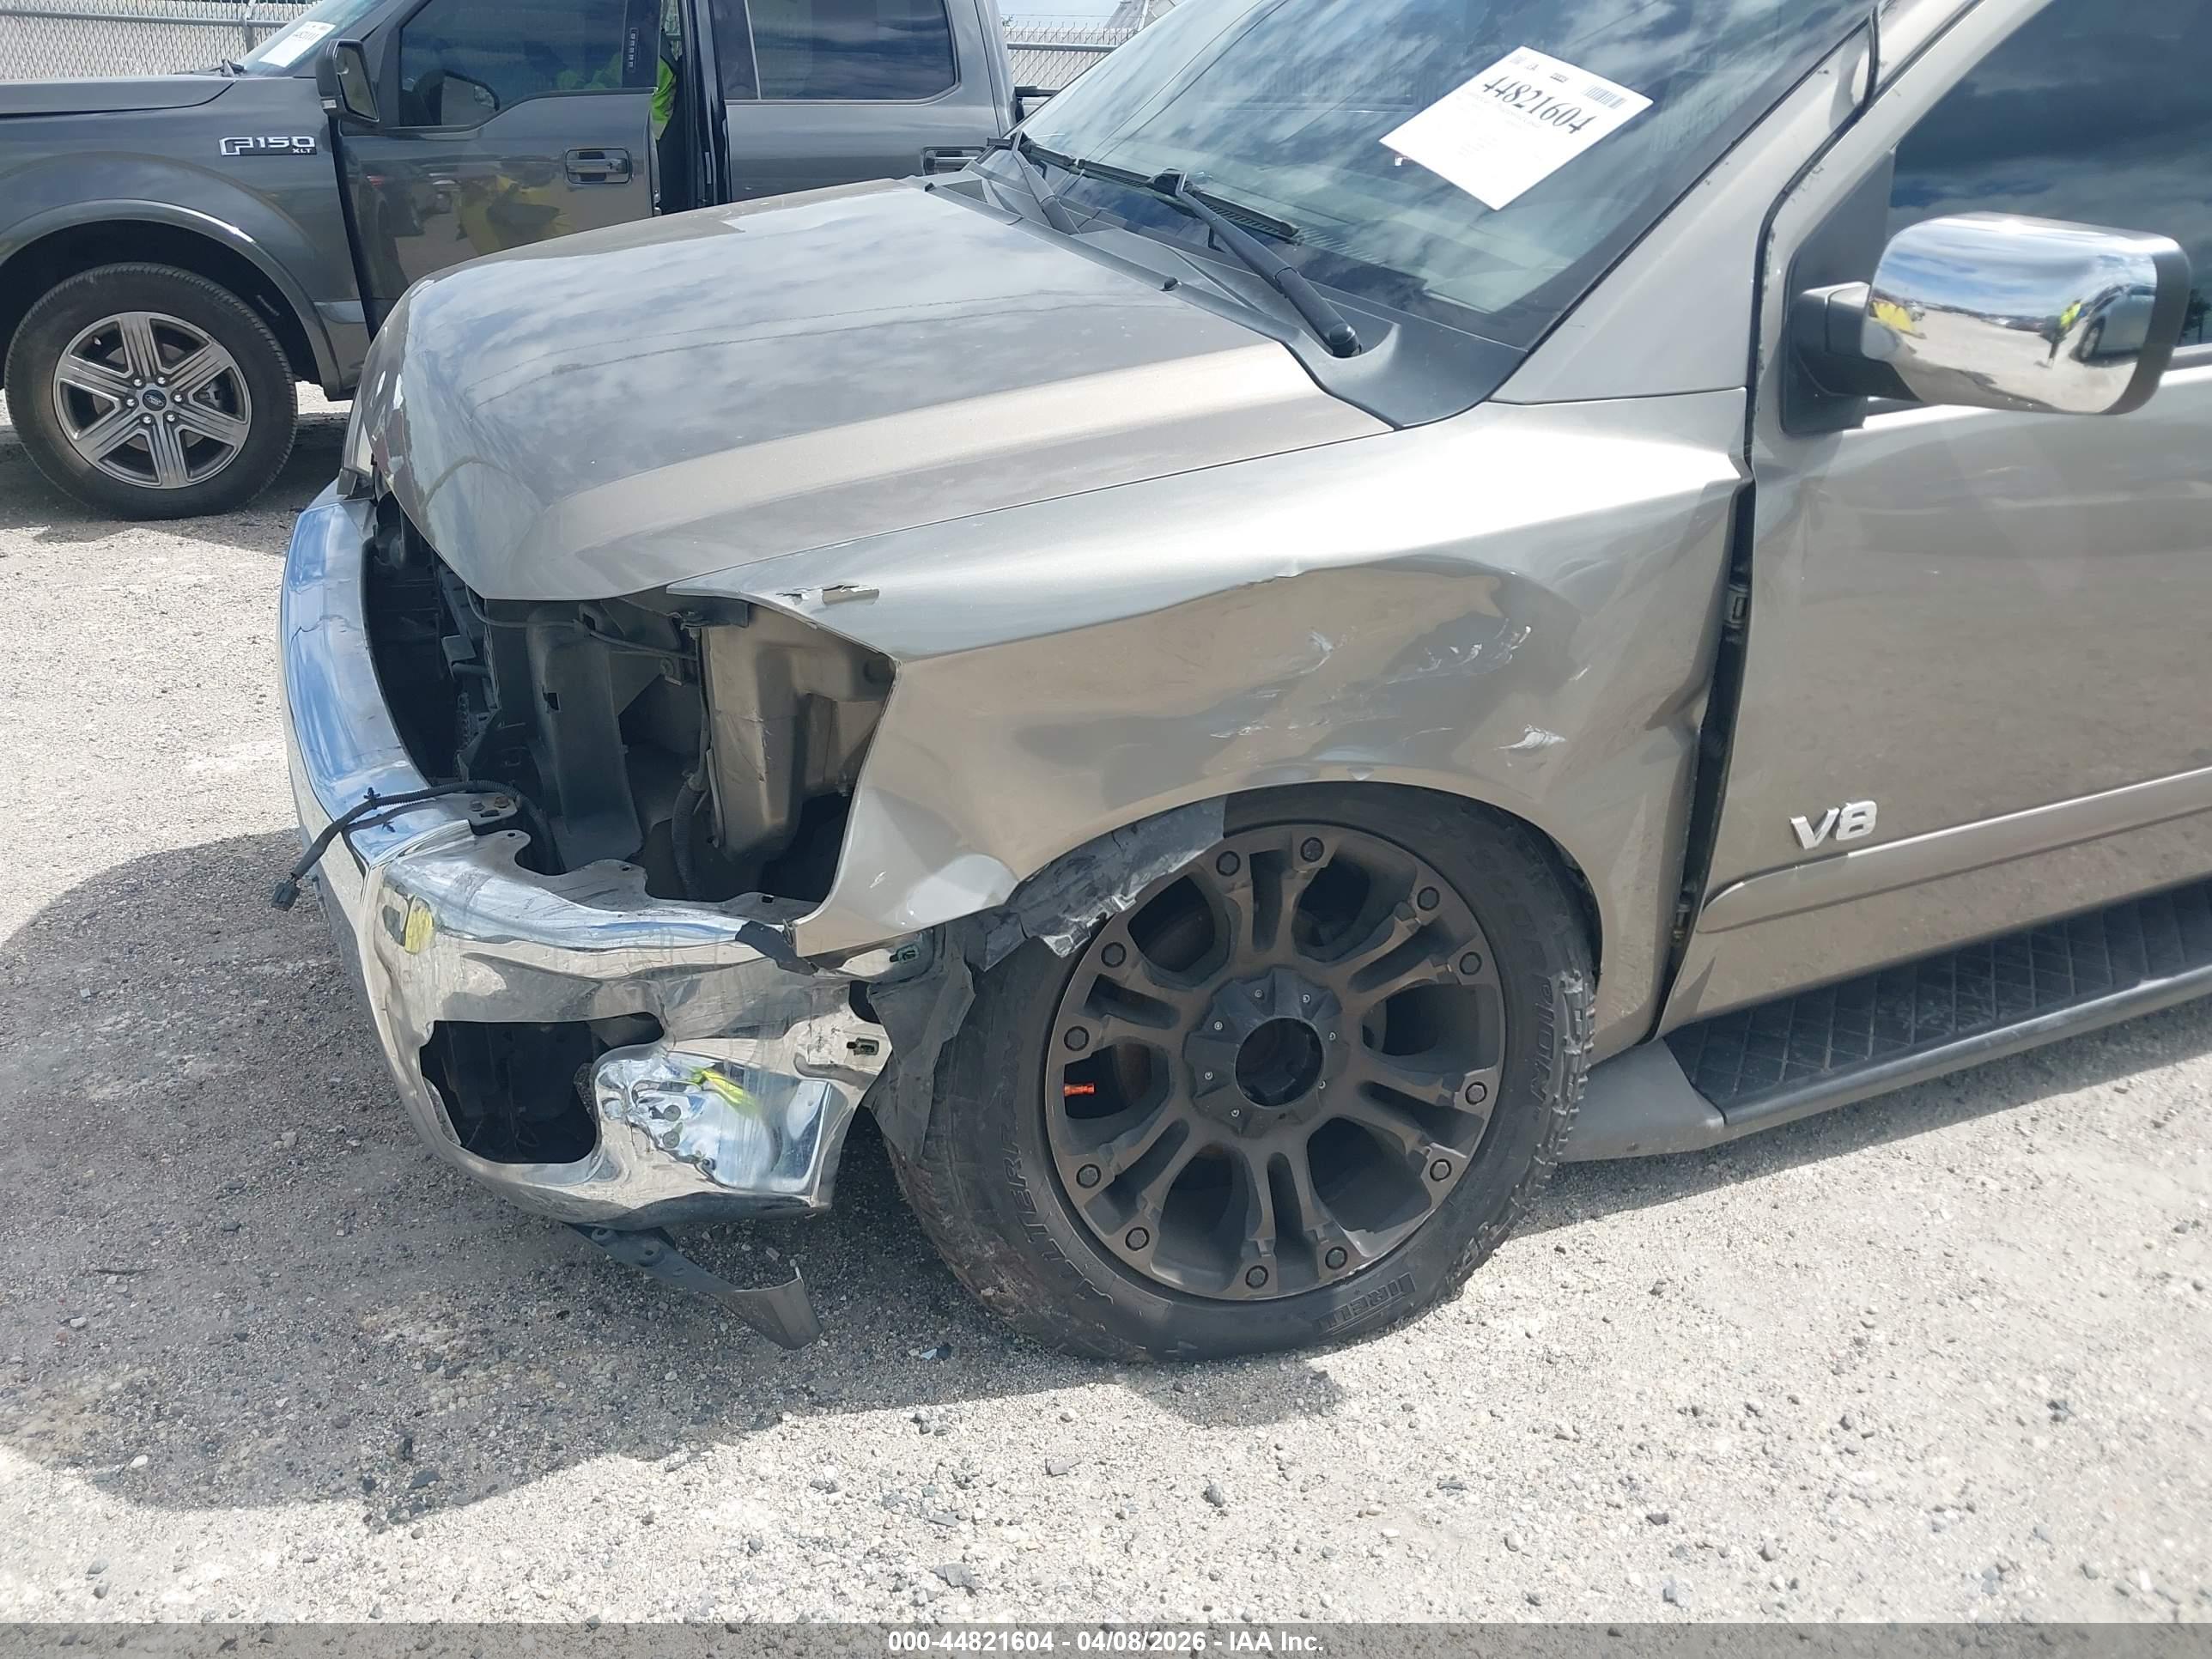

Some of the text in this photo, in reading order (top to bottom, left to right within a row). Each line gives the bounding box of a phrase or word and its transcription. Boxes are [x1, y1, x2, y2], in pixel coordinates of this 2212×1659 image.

[1483, 76, 1597, 134] 44821604
[219, 137, 315, 155] F150
[1790, 799, 1878, 850] V8
